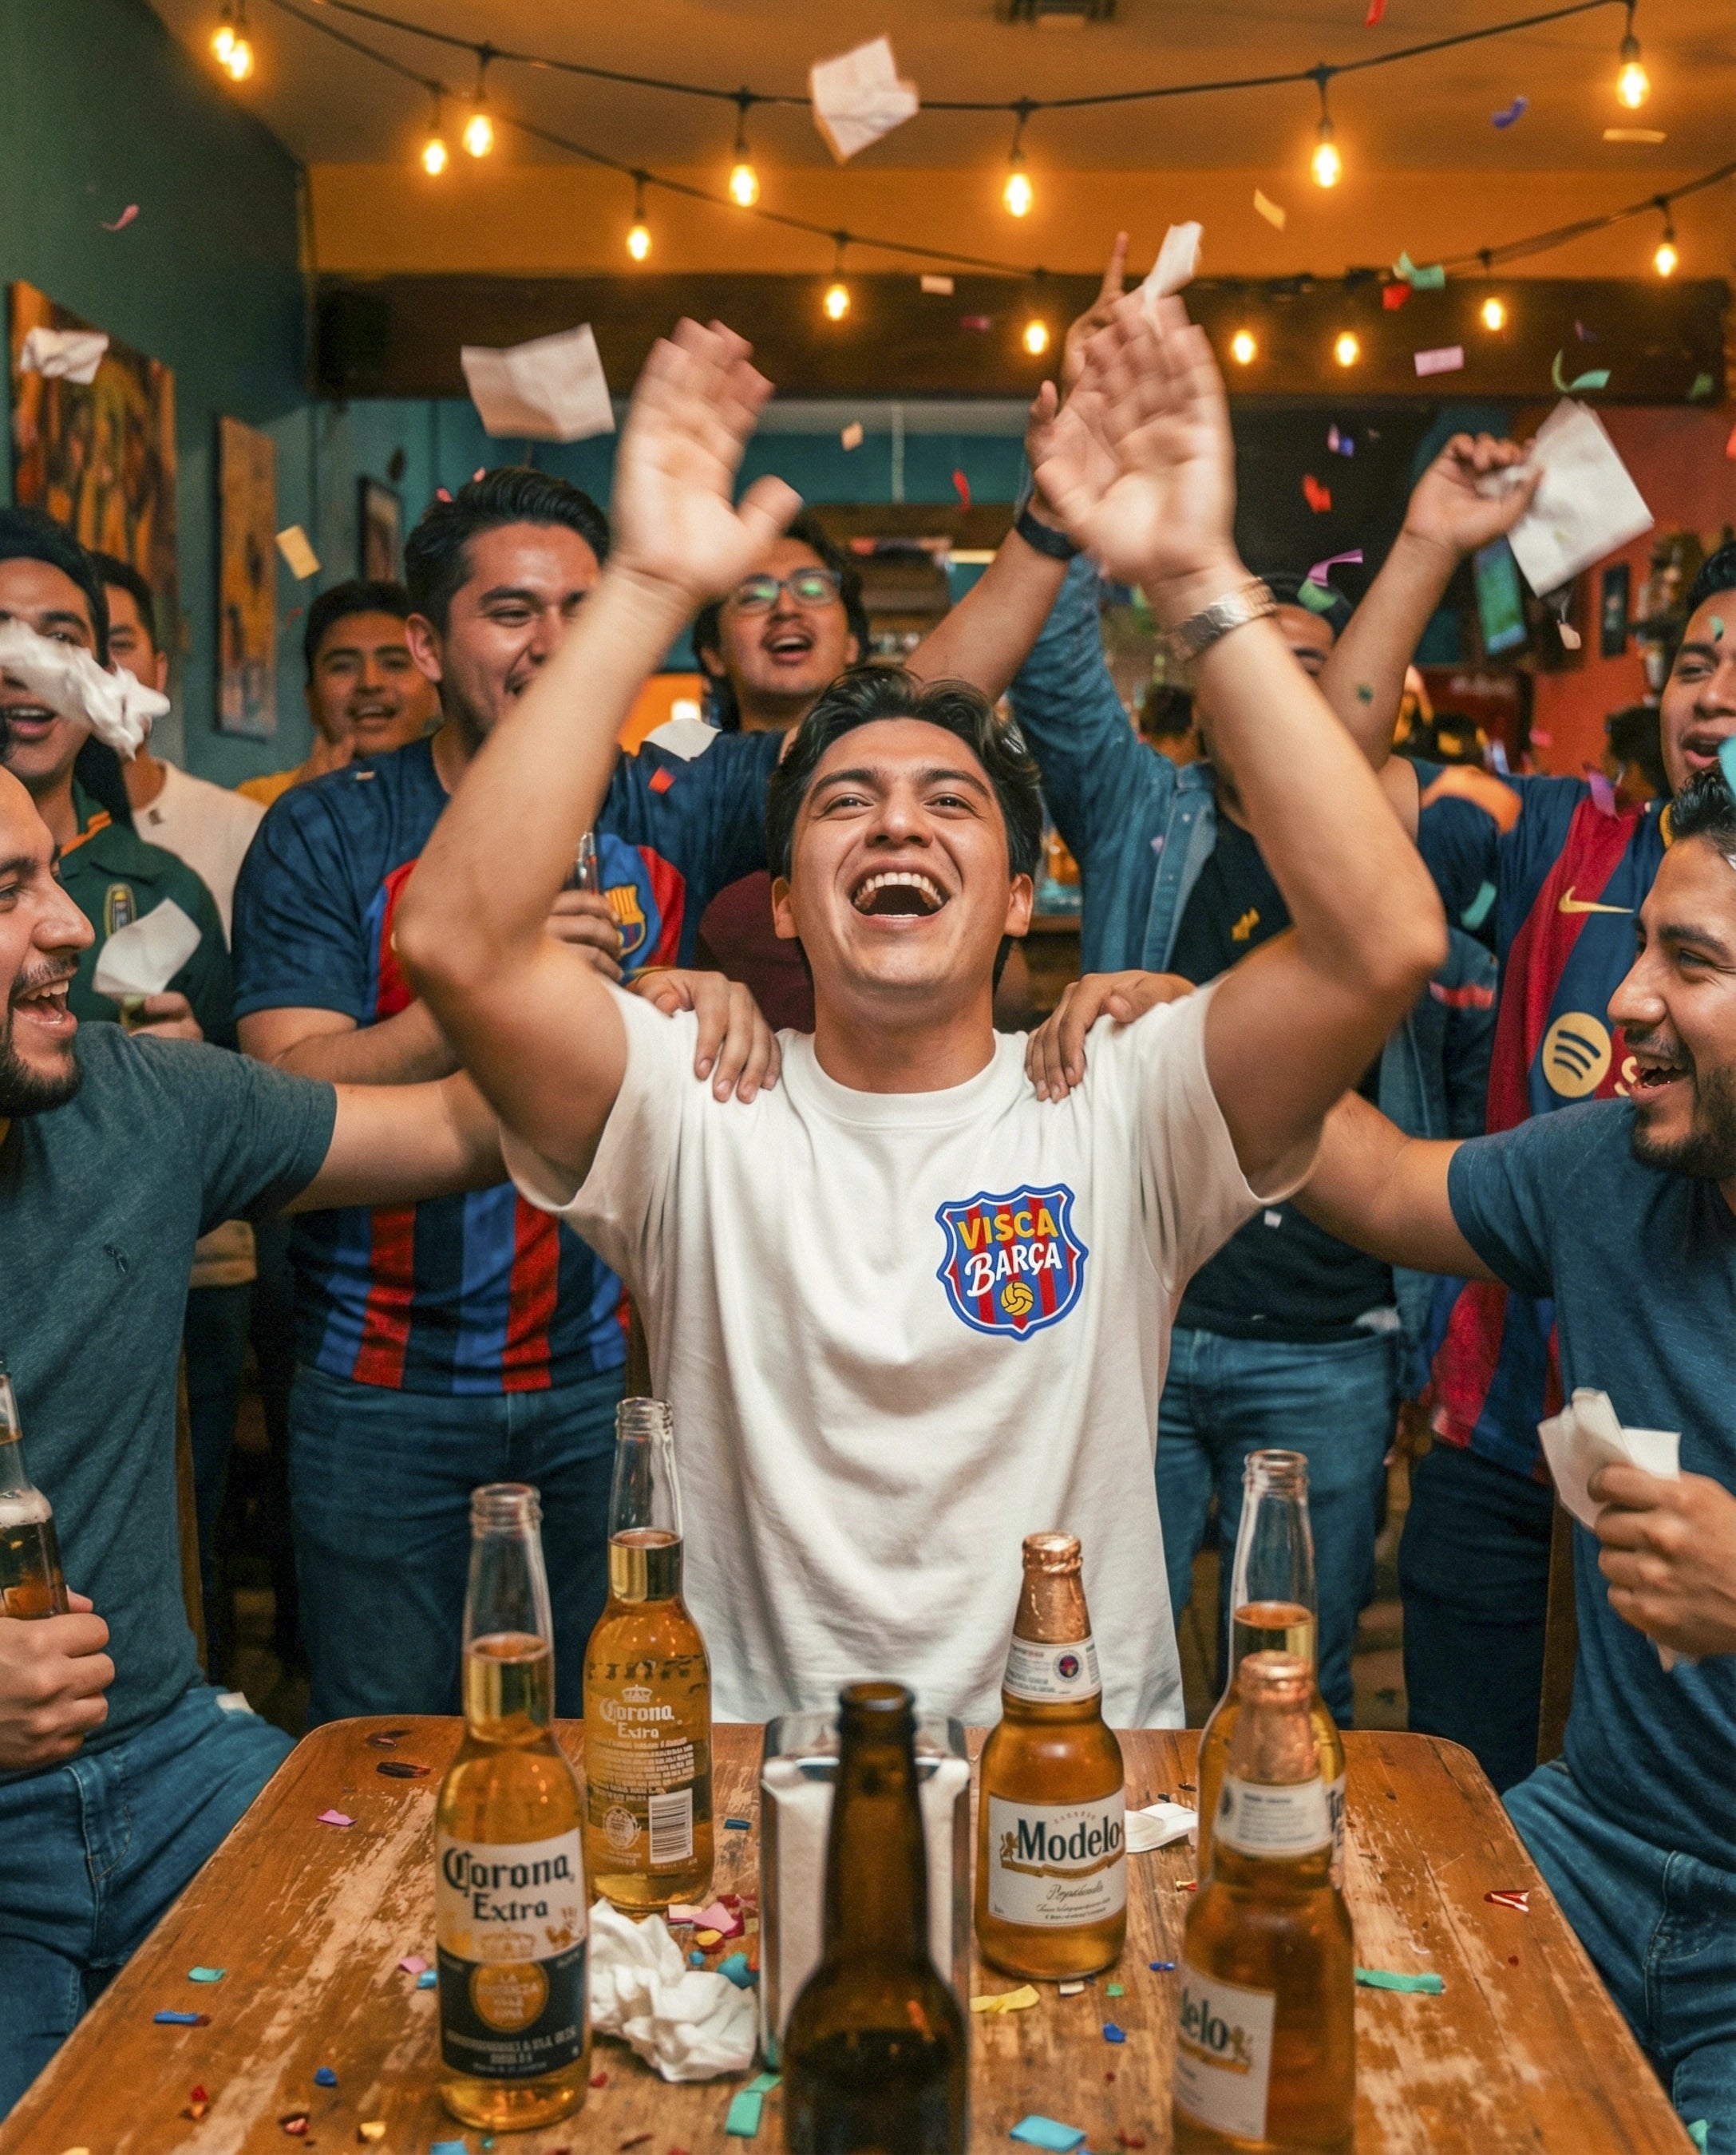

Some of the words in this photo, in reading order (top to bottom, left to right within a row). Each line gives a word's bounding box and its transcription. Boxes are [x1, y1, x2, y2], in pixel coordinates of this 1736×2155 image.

[956, 1208, 1059, 1251] VISCA
[964, 1242, 1062, 1297] BARÇA
[599, 1698, 674, 1725] Corona
[618, 1722, 659, 1738] Extra
[1018, 1814, 1120, 1861] Modelo
[443, 1847, 569, 1898] Corona
[473, 1892, 548, 1921] Extra
